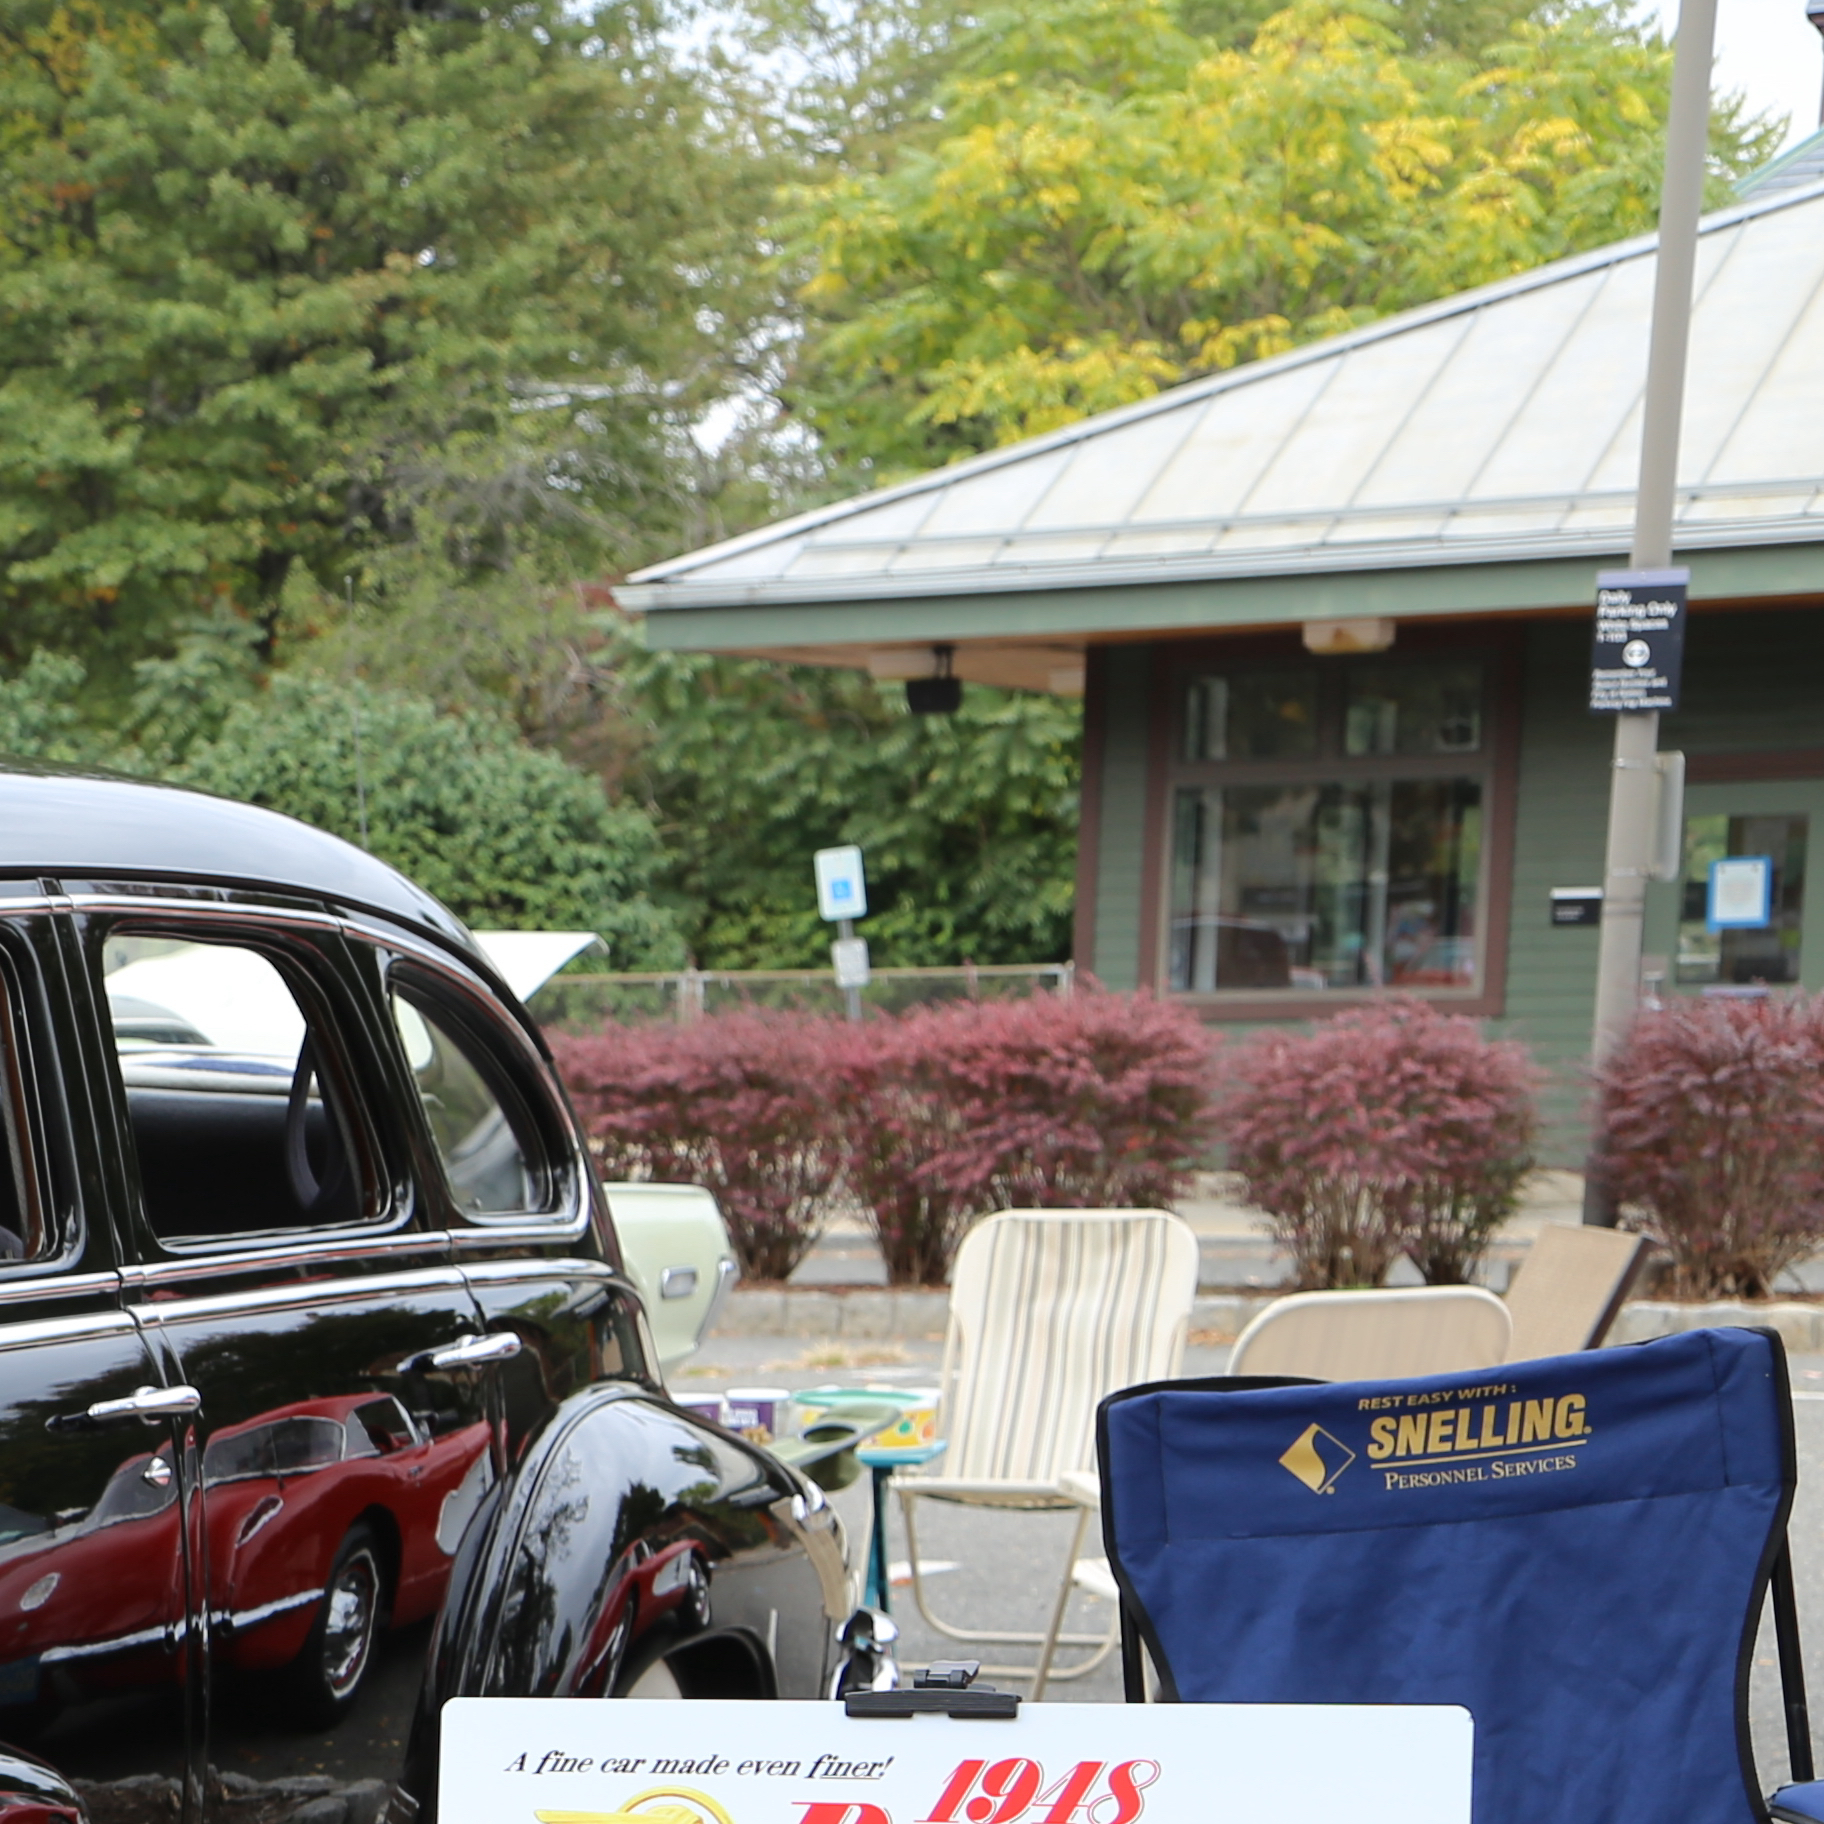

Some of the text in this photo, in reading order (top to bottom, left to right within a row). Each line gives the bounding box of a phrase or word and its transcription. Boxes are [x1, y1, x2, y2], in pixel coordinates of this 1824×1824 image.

[1358, 1395, 1404, 1411] REST
[1406, 1390, 1454, 1407] EASY
[1384, 1455, 1577, 1490] PERSONNEL SERVICES
[504, 1749, 895, 1780] A fine car made even finer!
